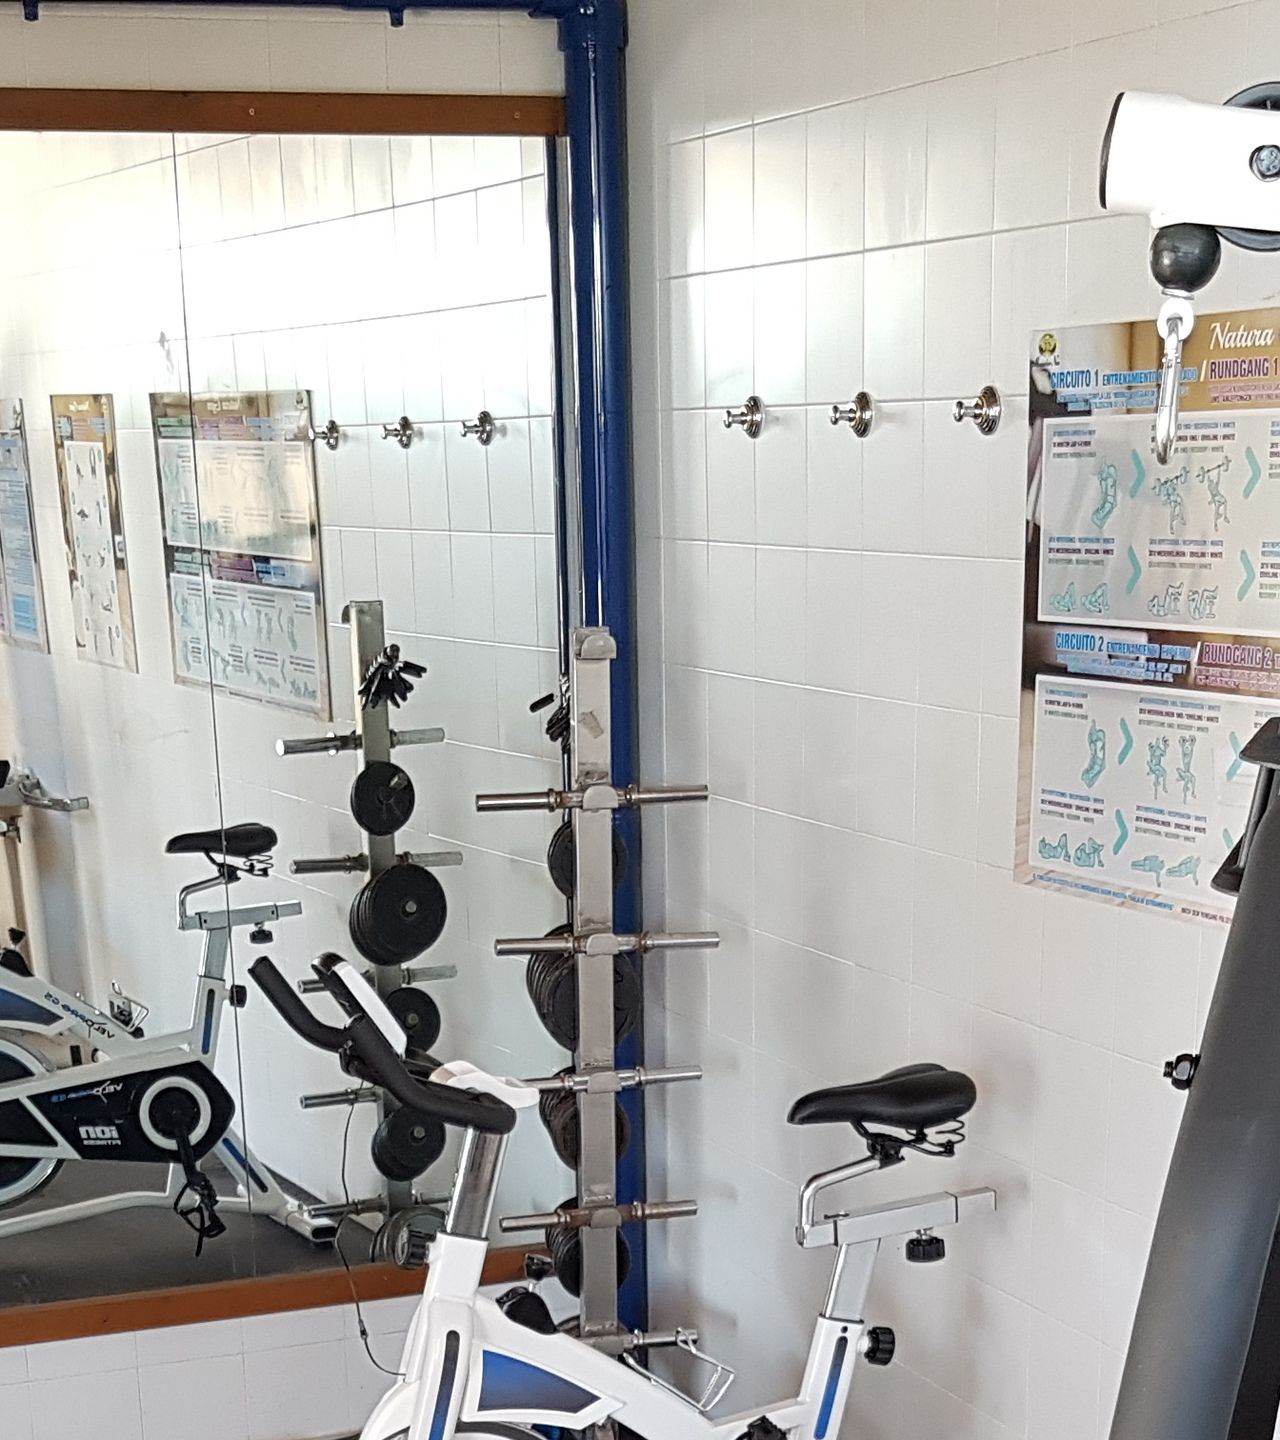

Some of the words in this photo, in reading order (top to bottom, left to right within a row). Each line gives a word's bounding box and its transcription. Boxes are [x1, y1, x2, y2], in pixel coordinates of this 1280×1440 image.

[1209, 321, 1275, 350] Natura
[1051, 369, 1091, 389] CIRCUITO
[1094, 369, 1099, 387] 1
[1209, 358, 1269, 380] RUNDGANG
[1272, 358, 1279, 376] 1
[1056, 632, 1096, 651] CIRCUITO
[1098, 636, 1104, 651] 2
[1203, 643, 1262, 667] RUNDGANG
[1264, 650, 1272, 667] 2
